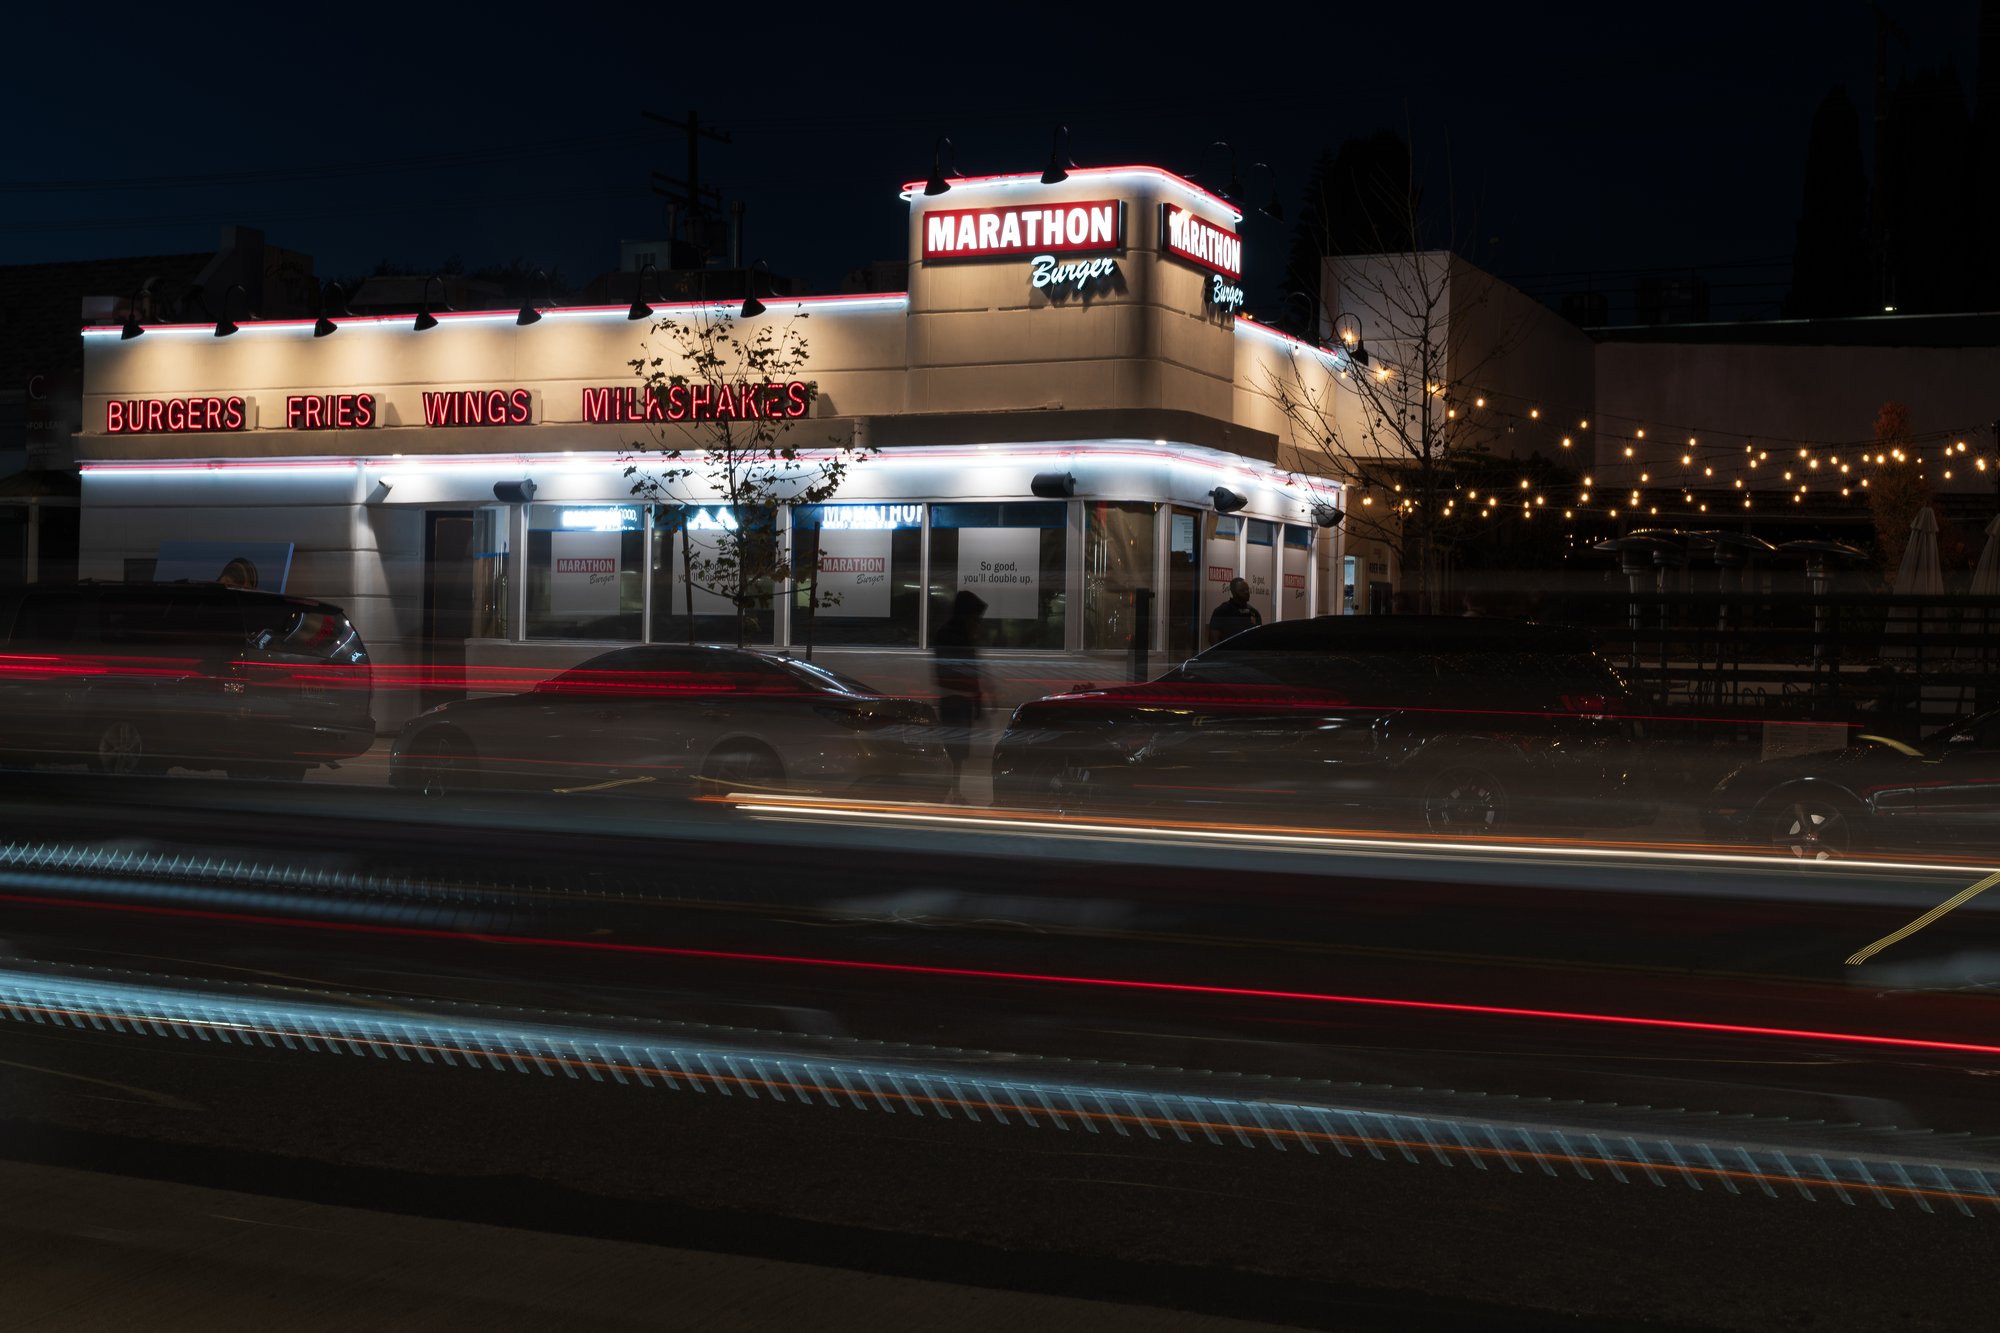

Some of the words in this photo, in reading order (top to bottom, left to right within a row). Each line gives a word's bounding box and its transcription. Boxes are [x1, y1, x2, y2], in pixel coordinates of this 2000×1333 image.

[928, 205, 1113, 252] MARATHON
[1169, 210, 1241, 274] MARATHON
[1031, 255, 1114, 290] Burger
[1213, 274, 1243, 312] Burger
[107, 397, 243, 432] BURGERS
[287, 393, 374, 429] FRIES
[423, 389, 531, 425] WINGS
[583, 382, 807, 422] MILKSHAKES
[559, 559, 613, 572] MARATHON
[589, 574, 614, 585] Burger
[823, 558, 881, 571] MARATHON
[856, 574, 884, 585] Burger
[964, 574, 986, 584] you'll
[988, 574, 1017, 583] double
[1020, 575, 1033, 584] up.
[980, 561, 991, 571] So
[994, 562, 1018, 573] good,
